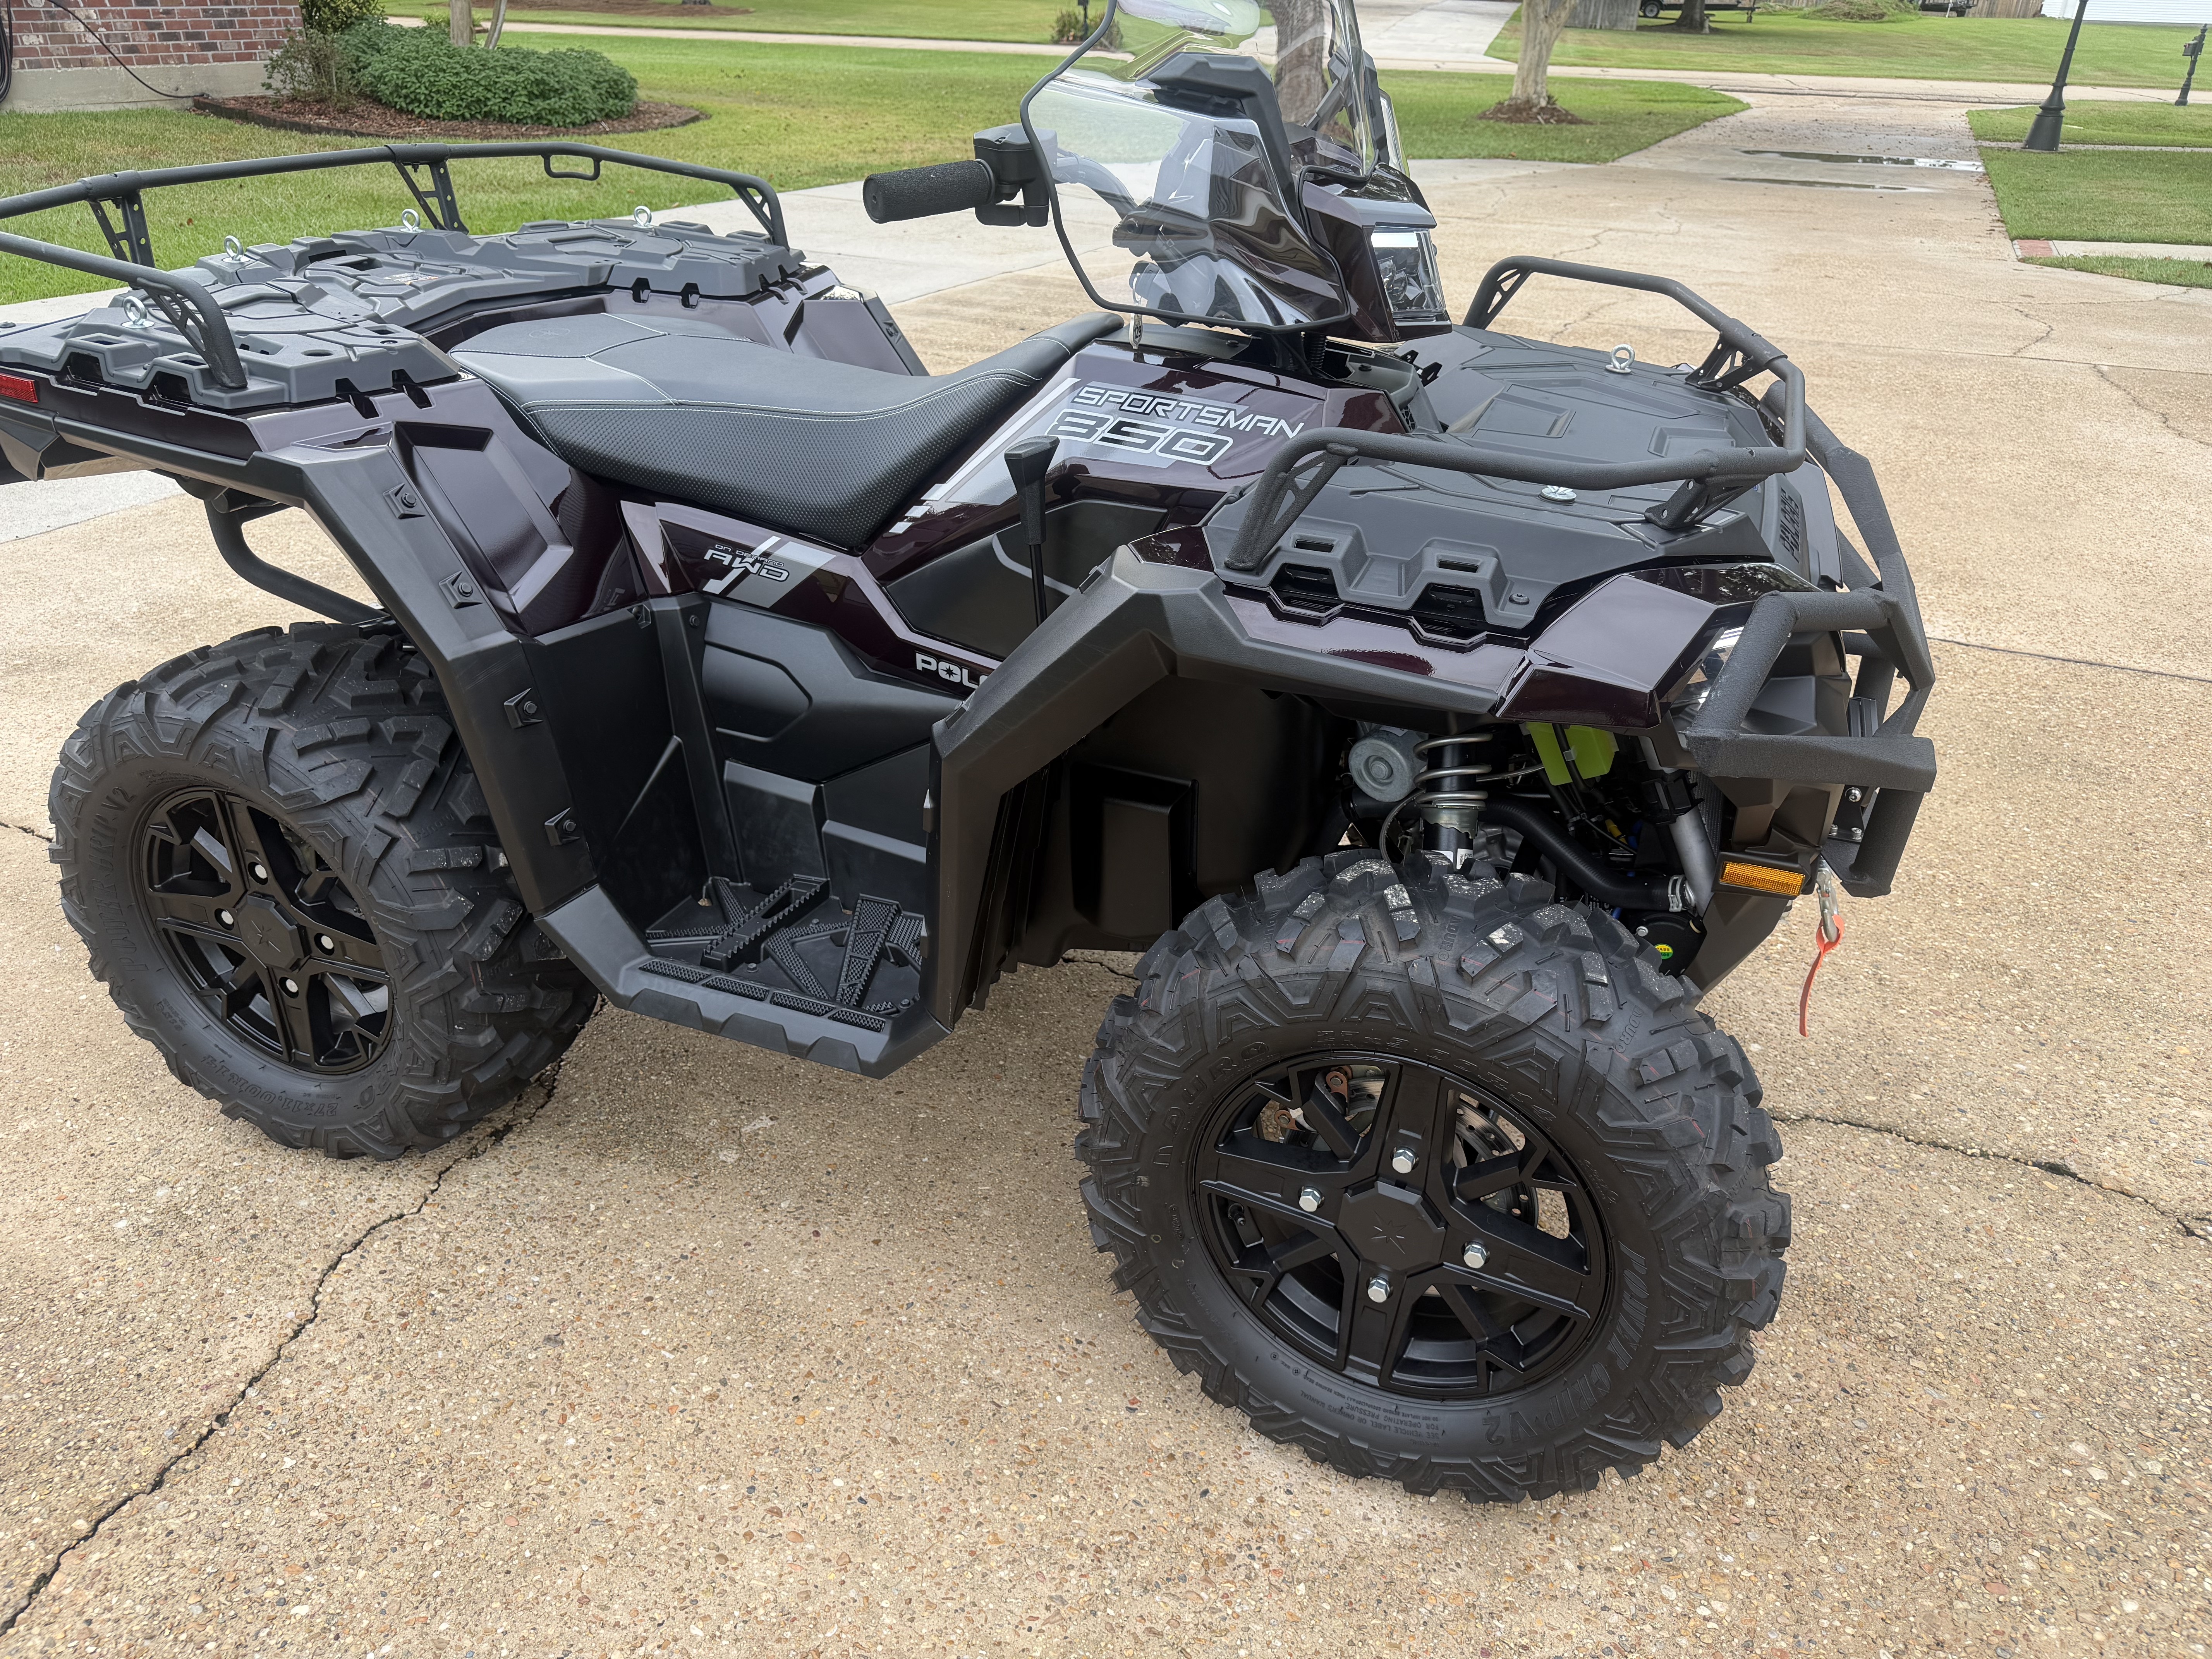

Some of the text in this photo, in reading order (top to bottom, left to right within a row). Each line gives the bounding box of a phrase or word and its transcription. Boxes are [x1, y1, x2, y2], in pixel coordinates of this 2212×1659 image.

[1072, 386, 1305, 439] SPORTSMAN
[1046, 408, 1233, 465] 850
[704, 549, 790, 582] AWD
[736, 550, 784, 567] DEMAND
[916, 653, 988, 689] POL
[1300, 1390, 1325, 1408] MANUAL
[1371, 1420, 1391, 1431] LABEL
[1384, 1415, 1422, 1428] OPERATING
[1394, 1428, 1423, 1437] VEHICLE
